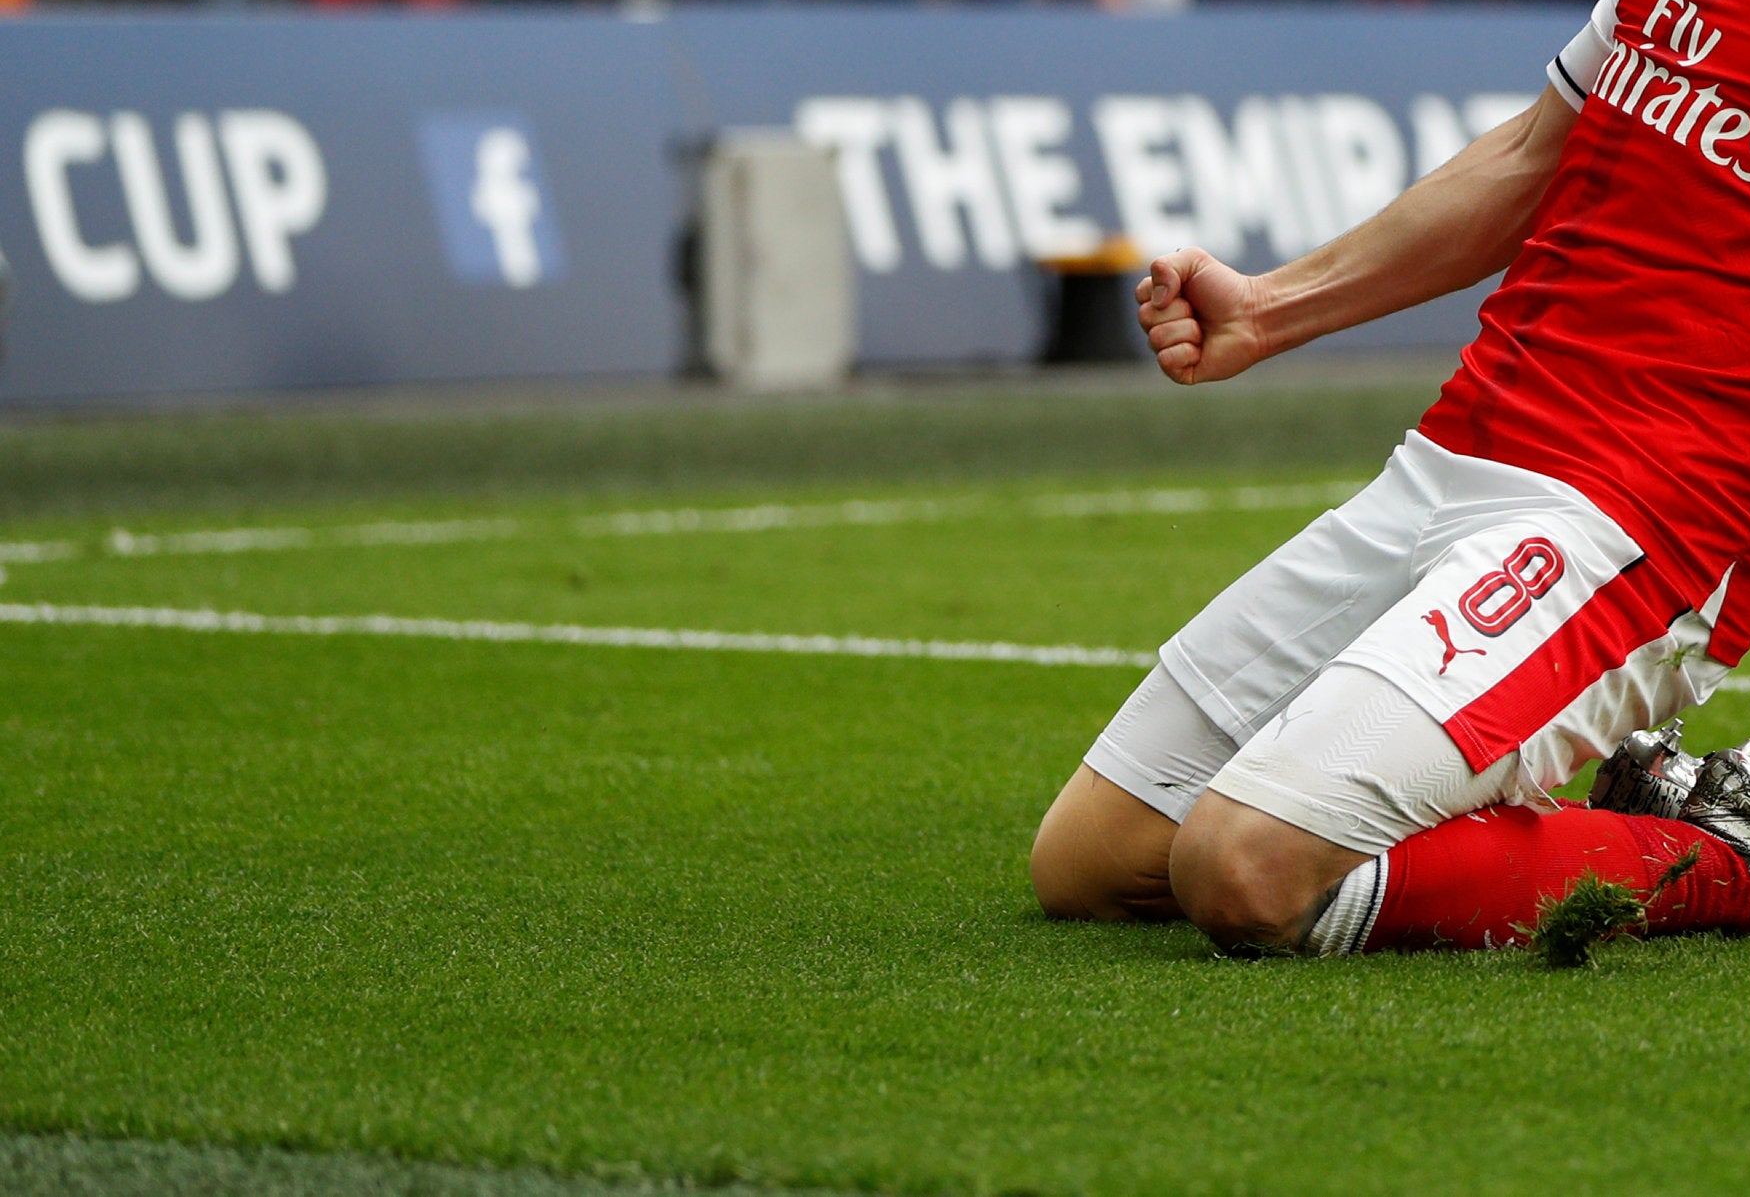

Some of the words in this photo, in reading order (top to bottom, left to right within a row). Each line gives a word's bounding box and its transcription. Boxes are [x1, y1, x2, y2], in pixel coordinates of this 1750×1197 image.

[23, 108, 327, 301] CUP
[796, 97, 1102, 272] THE
[1458, 536, 1565, 637] 8
